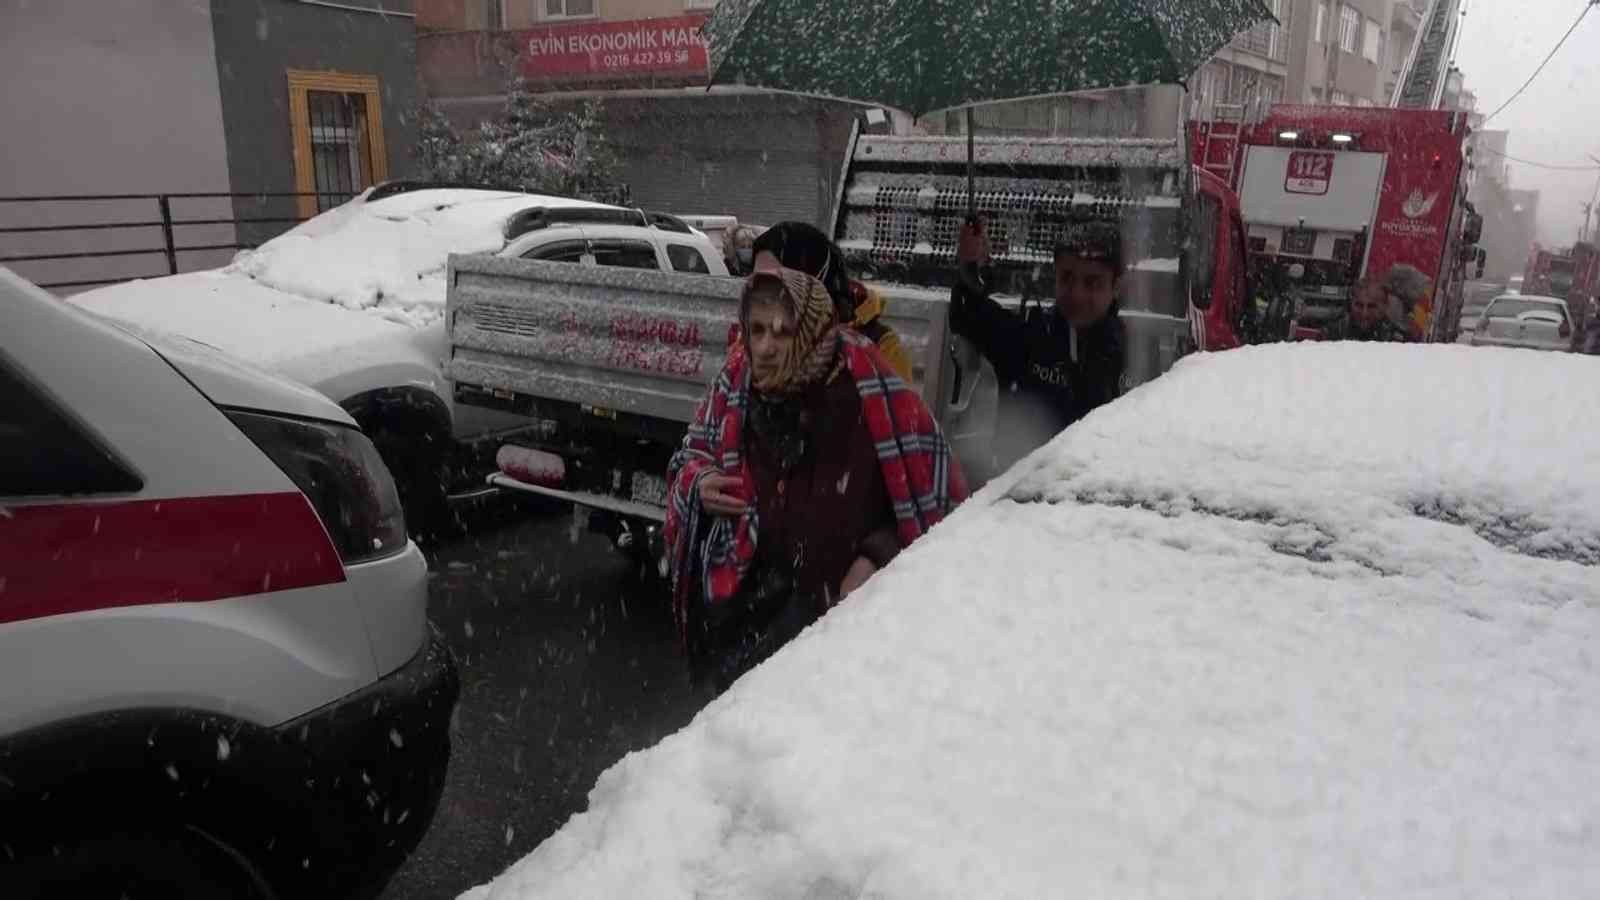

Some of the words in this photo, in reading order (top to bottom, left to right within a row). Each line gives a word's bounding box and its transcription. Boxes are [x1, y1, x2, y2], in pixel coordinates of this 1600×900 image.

[529, 33, 565, 56] EVİN
[569, 28, 658, 53] EKONOMİK
[662, 27, 705, 47] MAR
[603, 53, 630, 67] 0216
[632, 52, 653, 65] 427
[656, 51, 672, 63] 39
[1294, 155, 1327, 177] 112
